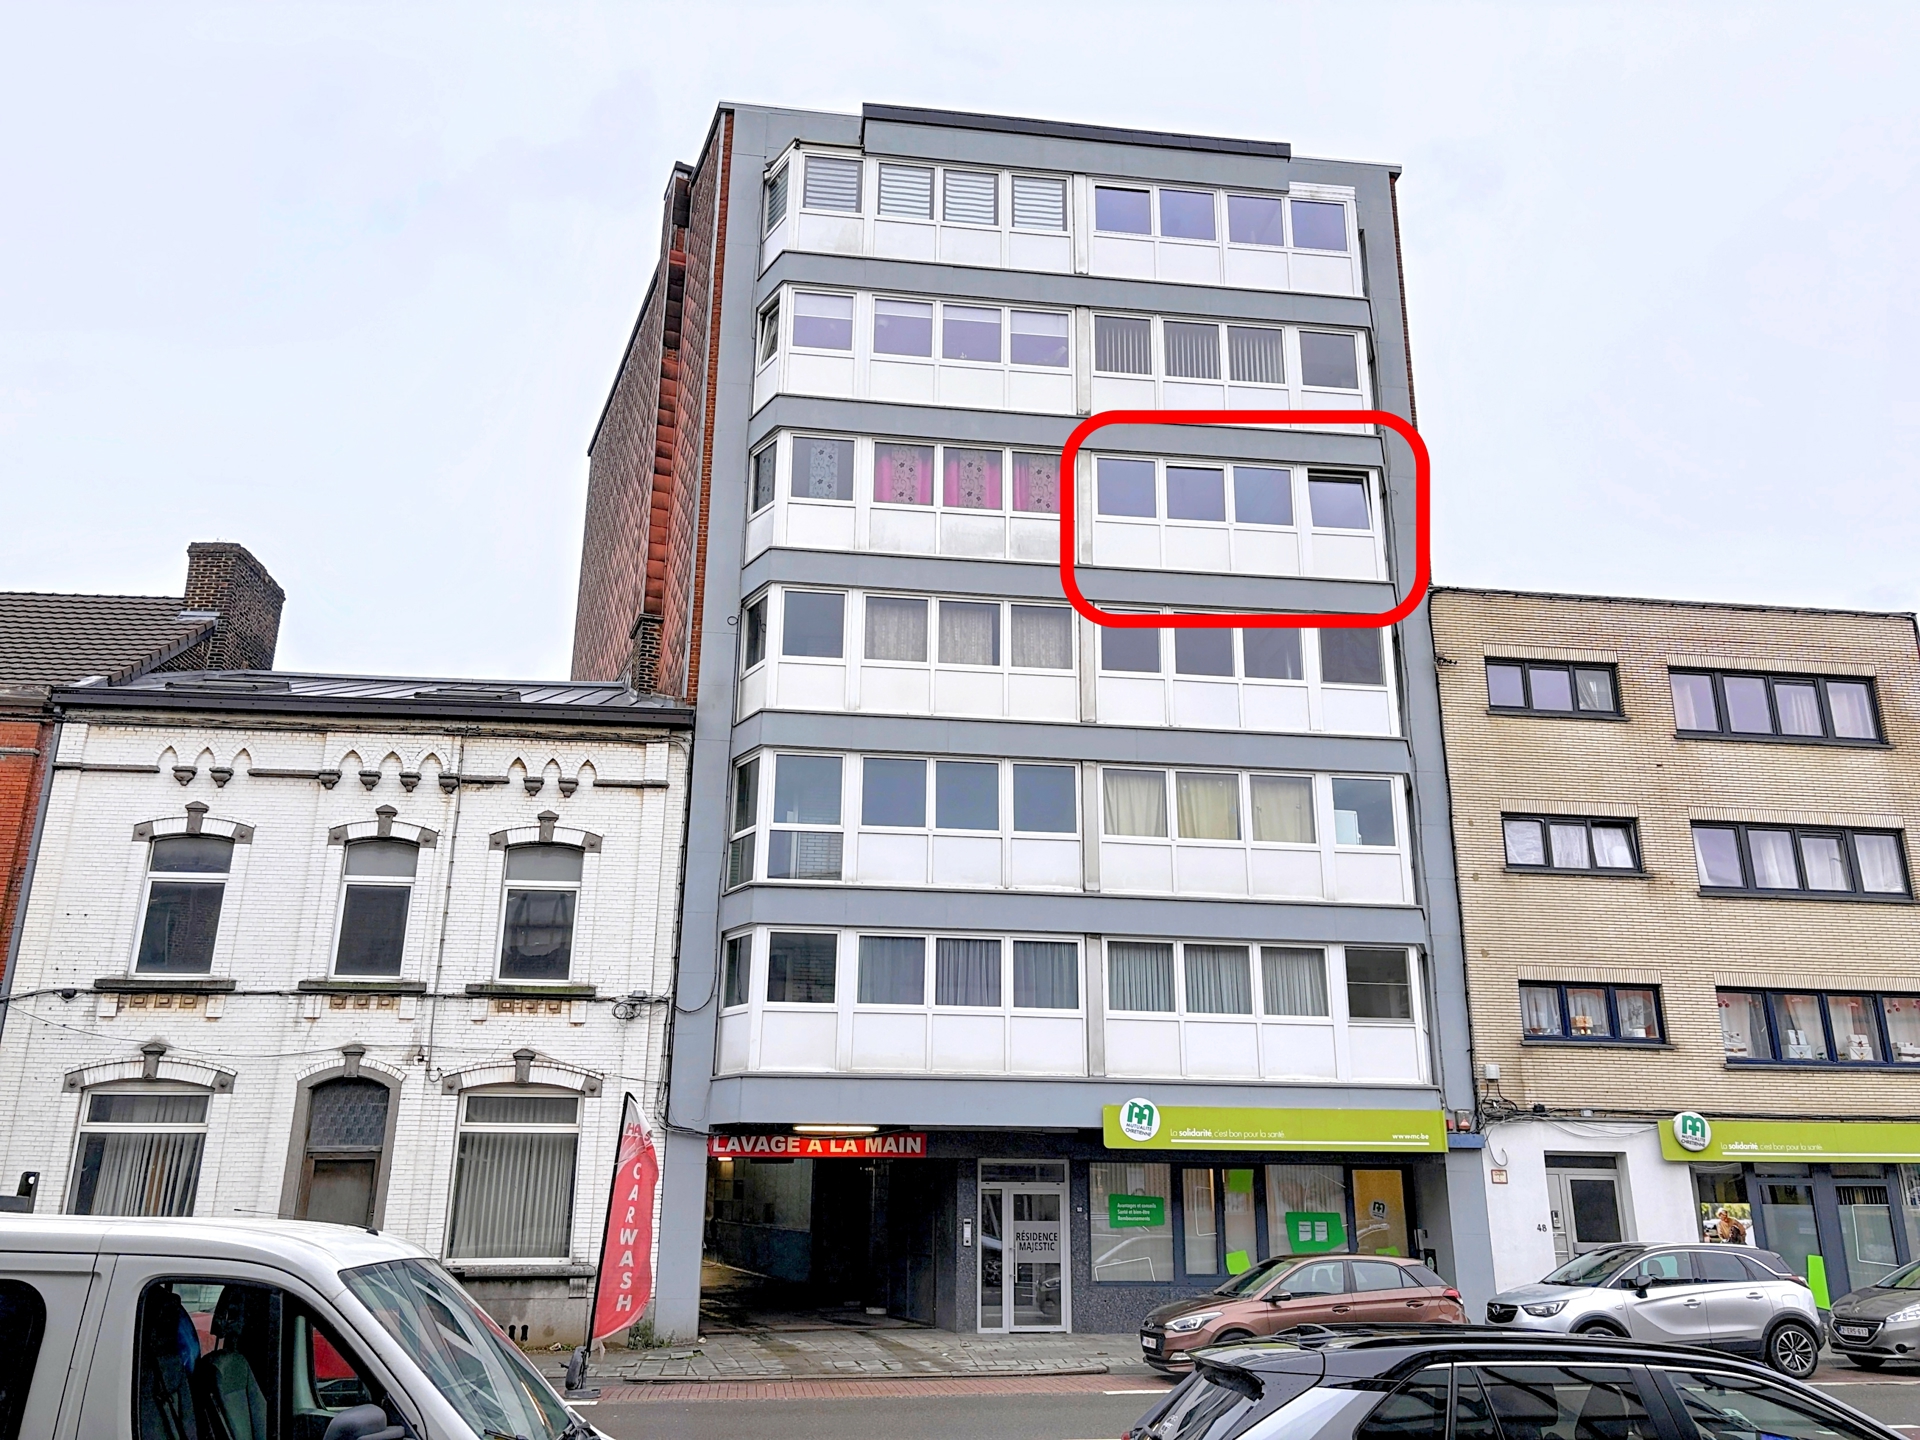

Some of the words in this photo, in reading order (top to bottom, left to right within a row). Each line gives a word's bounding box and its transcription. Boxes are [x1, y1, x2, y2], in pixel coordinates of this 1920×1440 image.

[1228, 1129, 1242, 1138] bon
[1243, 1131, 1258, 1139] pour
[1260, 1129, 1267, 1138] la
[713, 1136, 800, 1152] LAVAGE
[830, 1138, 858, 1153] LA
[865, 1137, 921, 1154] MAIN
[1773, 1143, 1785, 1151] bon
[1786, 1144, 1799, 1152] pour
[1800, 1143, 1807, 1151] la
[1537, 1223, 1547, 1232] 48
[1015, 1230, 1058, 1241] RÉSIDENCE
[1019, 1242, 1055, 1253] MAJESTIC
